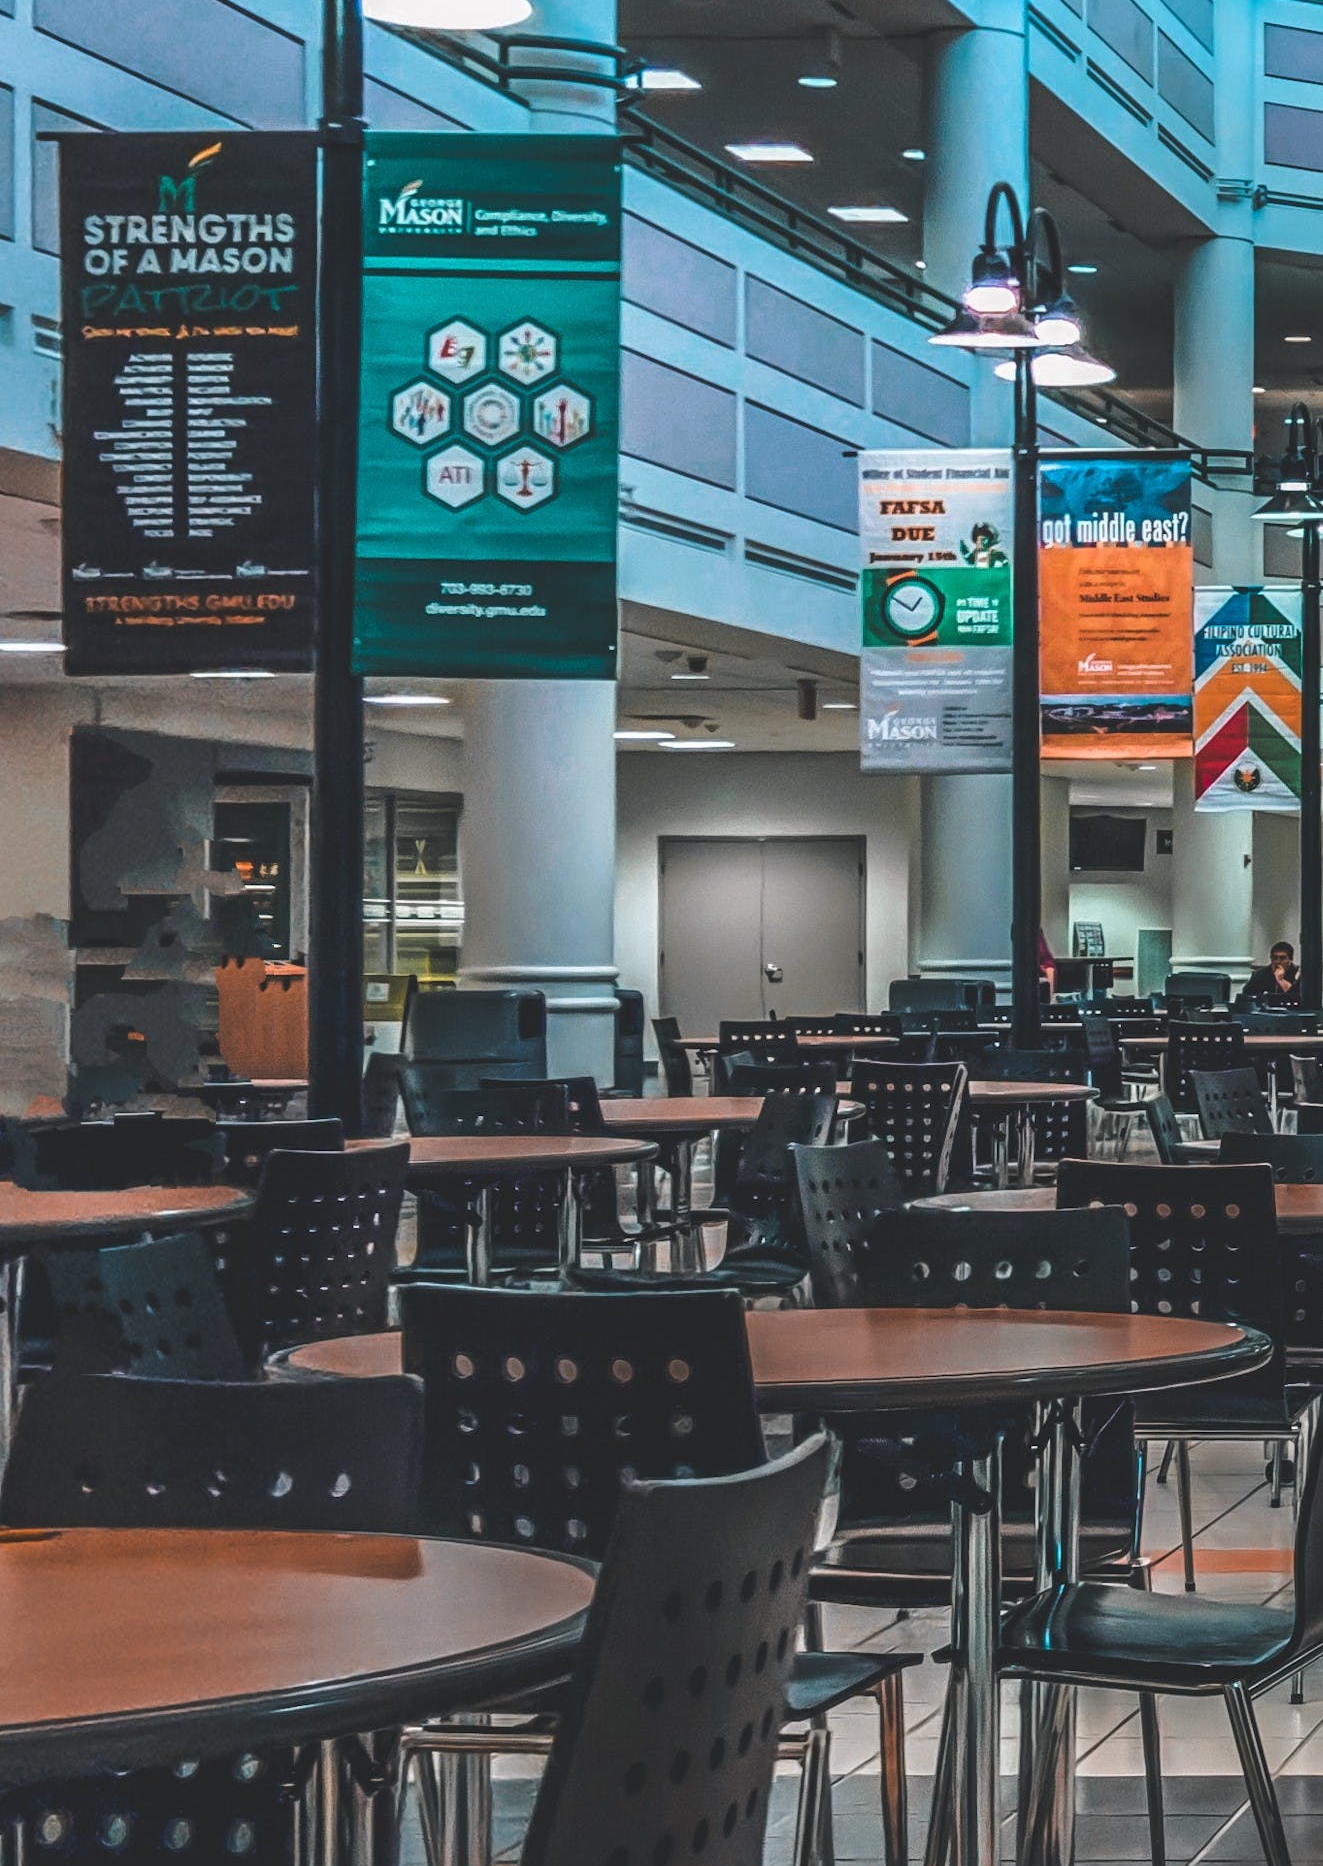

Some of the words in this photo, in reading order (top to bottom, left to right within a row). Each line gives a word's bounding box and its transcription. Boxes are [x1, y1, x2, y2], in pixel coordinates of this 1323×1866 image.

[379, 199, 463, 225] MASON
[84, 214, 296, 245] STRENGTHS
[475, 226, 498, 236] and
[501, 225, 538, 236] Ethics
[84, 248, 129, 275] OF
[136, 248, 161, 274] A
[170, 247, 293, 274] MASON
[81, 284, 298, 318] PATRIOT
[439, 466, 471, 484] ATI
[907, 468, 943, 479] Student
[879, 500, 945, 515] FAFSA
[891, 526, 935, 542] DUE
[1043, 513, 1071, 549] got
[1077, 512, 1136, 543] middle
[1142, 511, 1189, 543] east?
[1079, 593, 1111, 603] Middle
[1113, 593, 1134, 603] East
[1137, 592, 1170, 603] Studies
[425, 602, 546, 618] diversity.gmu.edu
[1203, 625, 1245, 640] FILIPINO
[1247, 625, 1299, 640] CULTURAL
[1216, 643, 1282, 658] ASSOCIATION
[1078, 660, 1113, 672] MASON
[867, 717, 937, 741] MASON
